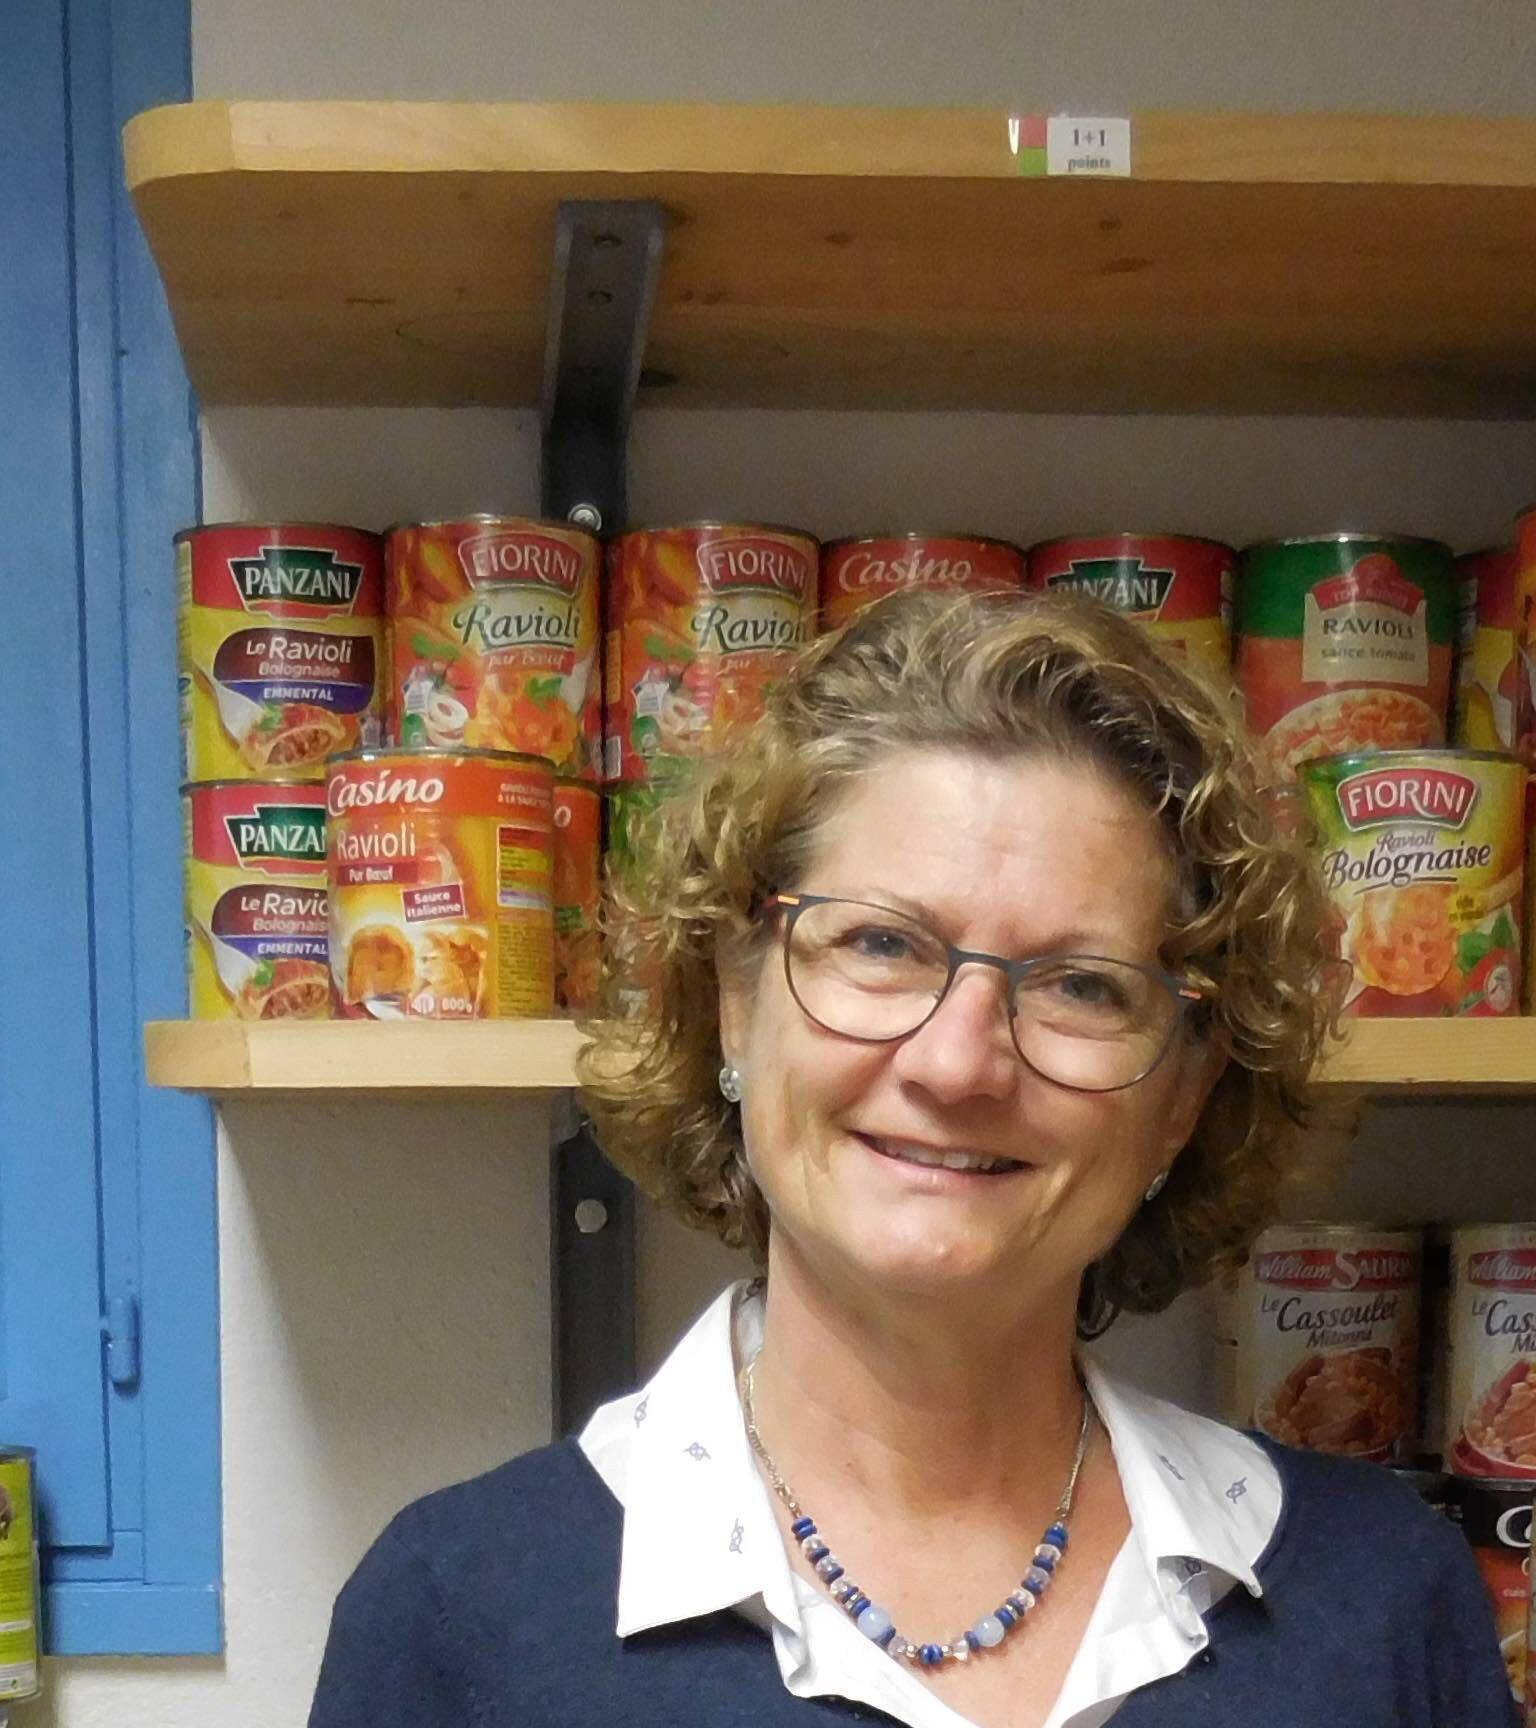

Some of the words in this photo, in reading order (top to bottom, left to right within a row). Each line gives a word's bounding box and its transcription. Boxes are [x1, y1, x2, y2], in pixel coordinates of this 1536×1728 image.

[1067, 155, 1111, 172] points
[472, 543, 578, 585] FIORINI
[710, 548, 808, 589] FIORINI
[839, 549, 973, 592] Casino
[244, 564, 352, 600] PANZANI
[452, 601, 581, 648] Ravioli
[1321, 616, 1415, 641] RAVIOLI
[269, 635, 352, 664] Ravioli
[1321, 646, 1364, 661] sauce
[258, 660, 341, 679] Bolognaise
[263, 687, 335, 702] EMMENTAL
[327, 768, 445, 817] Casino
[1347, 778, 1466, 821] FIORINI
[240, 823, 328, 854] PANZA
[337, 821, 417, 860] Ravioli
[1322, 840, 1492, 890] Bolognaise
[240, 895, 260, 912] Le
[263, 892, 328, 917] Ravio
[413, 890, 451, 905] Sauce
[253, 916, 328, 934] Bolognais
[257, 943, 327, 957] EMMENTAL
[1276, 1295, 1402, 1334] Cassoulet
